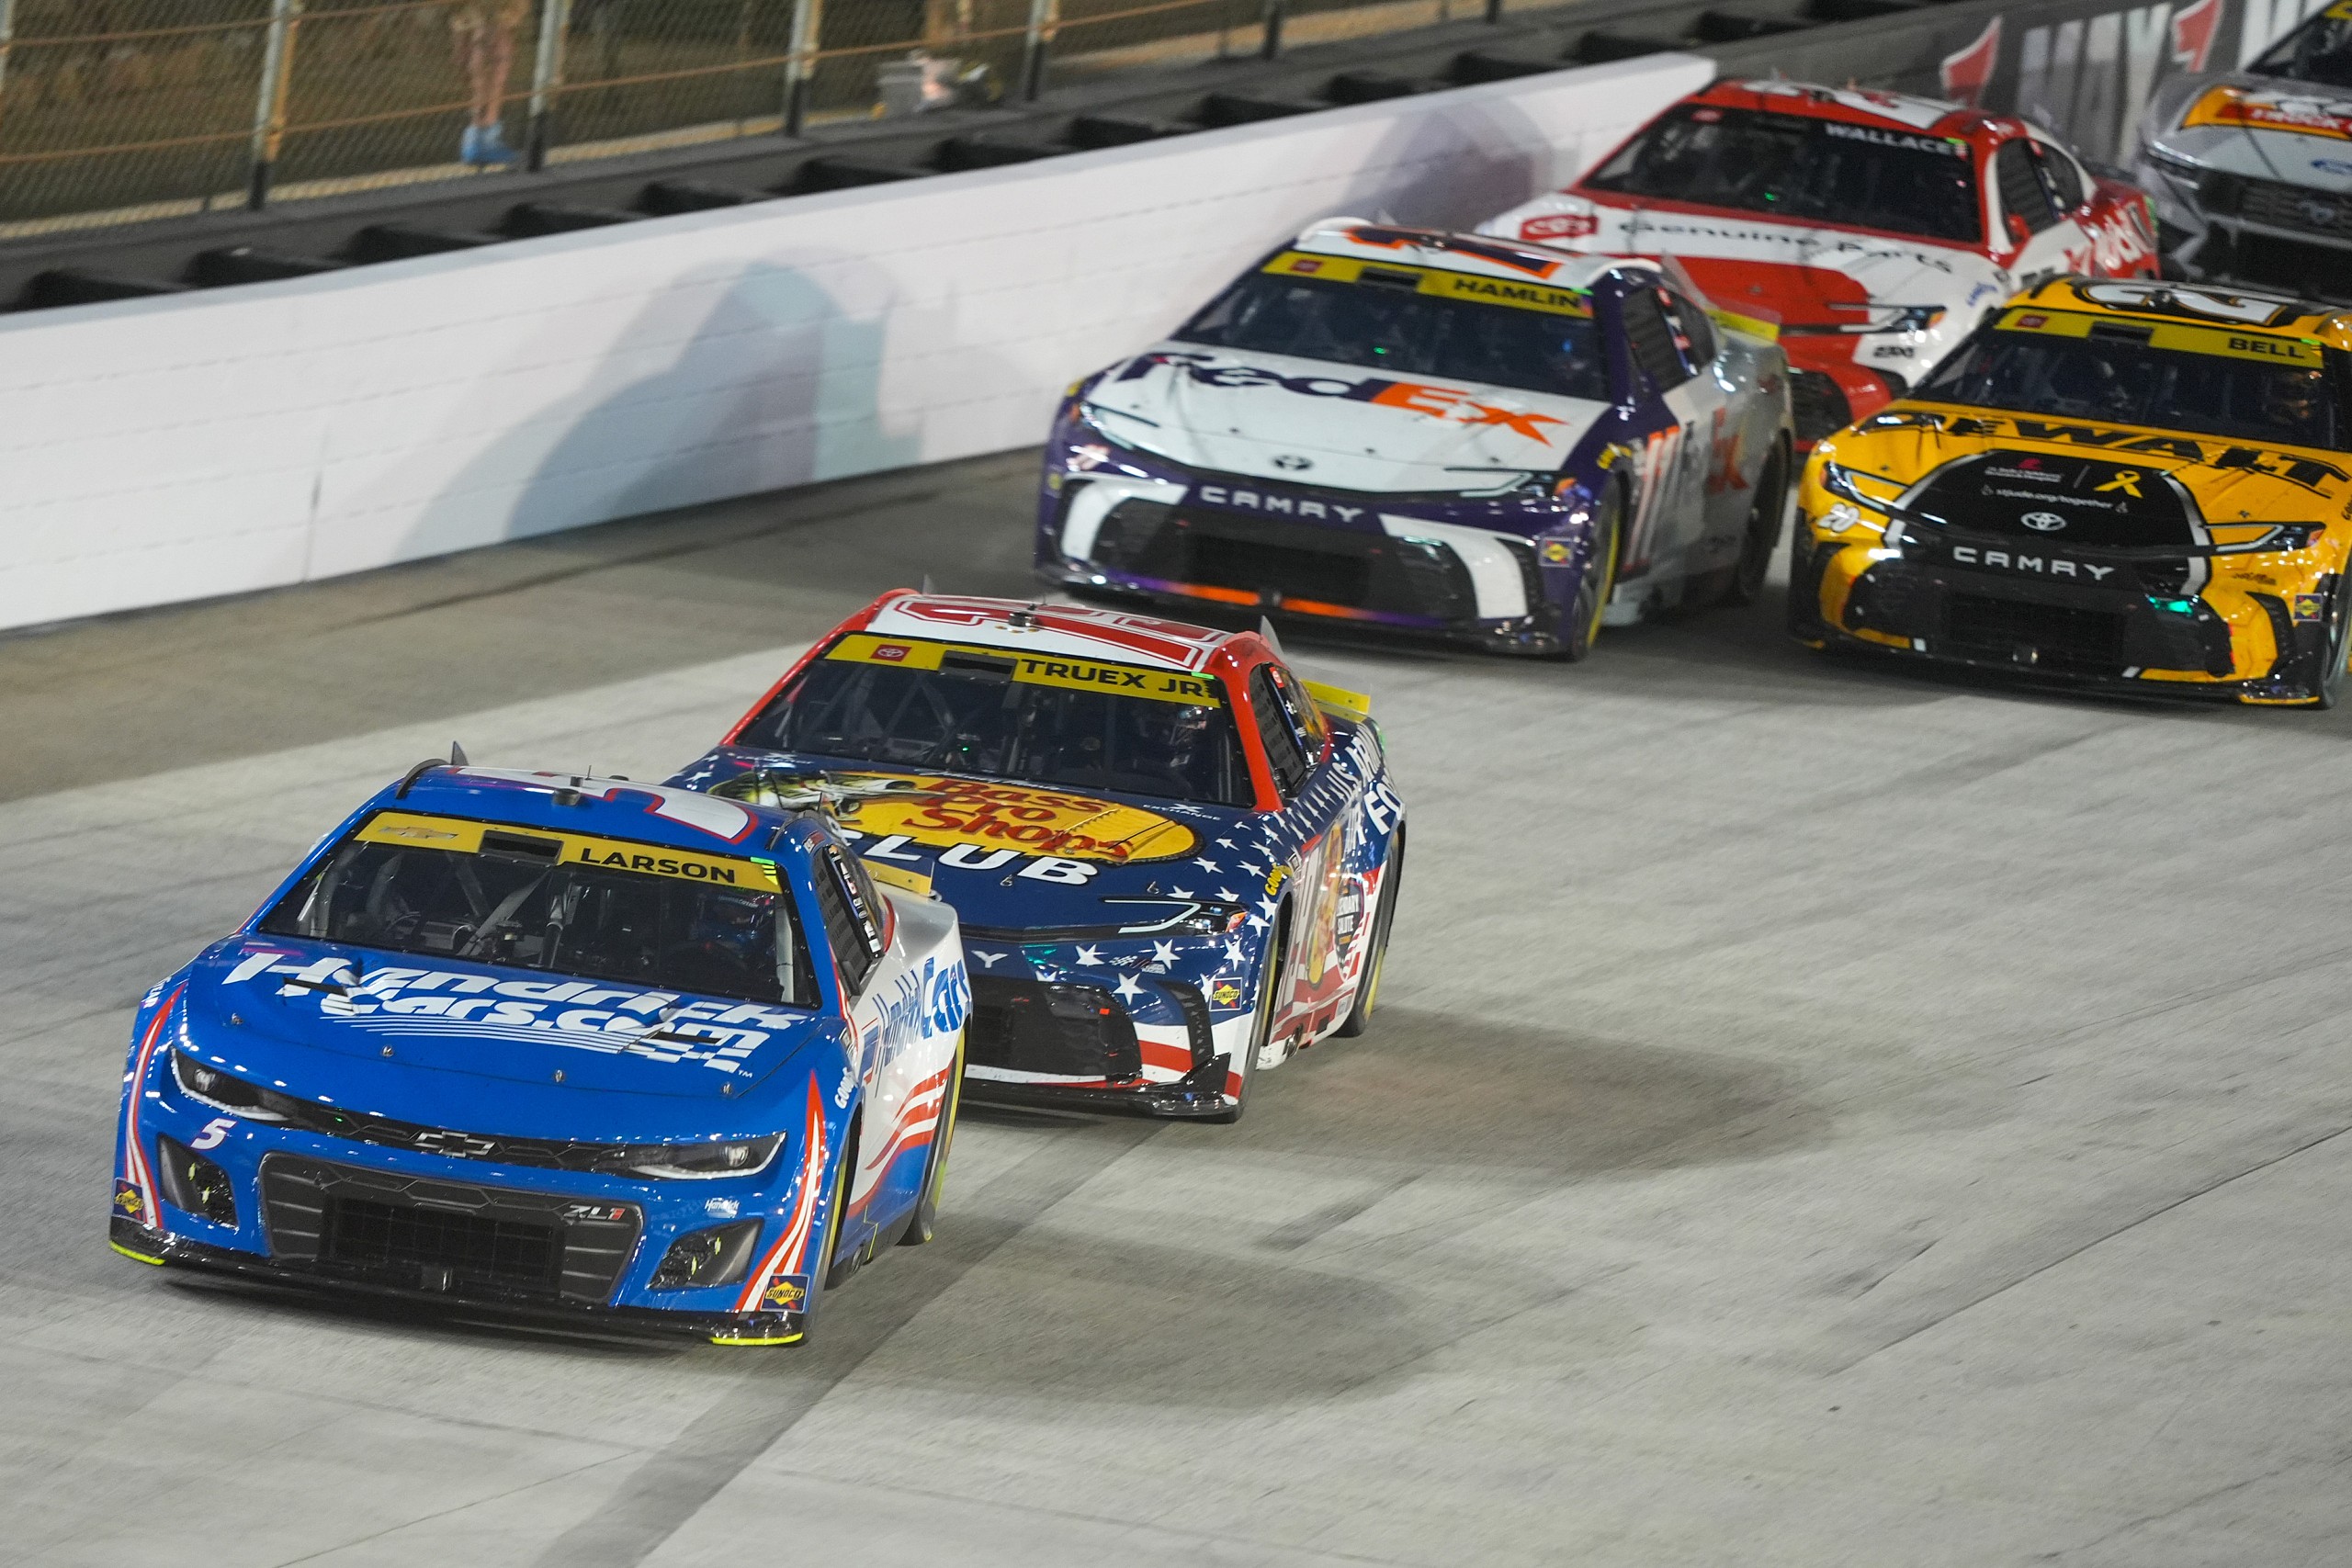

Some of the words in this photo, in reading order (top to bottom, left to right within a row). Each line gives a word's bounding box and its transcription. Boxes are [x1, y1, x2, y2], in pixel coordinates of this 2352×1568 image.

[1825, 122, 1952, 155] WALLACE
[1619, 220, 1821, 248] Genuine
[1453, 278, 1581, 309] HAMLIN
[2228, 337, 2305, 359] BELL
[1200, 485, 1364, 524] CAMRY
[1952, 546, 2116, 581] CAMRY
[1021, 658, 1147, 690] TRUEX
[912, 793, 1057, 821] Pro
[917, 780, 1108, 813] Bass
[901, 808, 1132, 862] Shops
[580, 848, 735, 884] LARSON
[189, 1117, 236, 1150] 5
[563, 1203, 627, 1221] ZL1
[766, 1288, 805, 1301] SUNOCO
